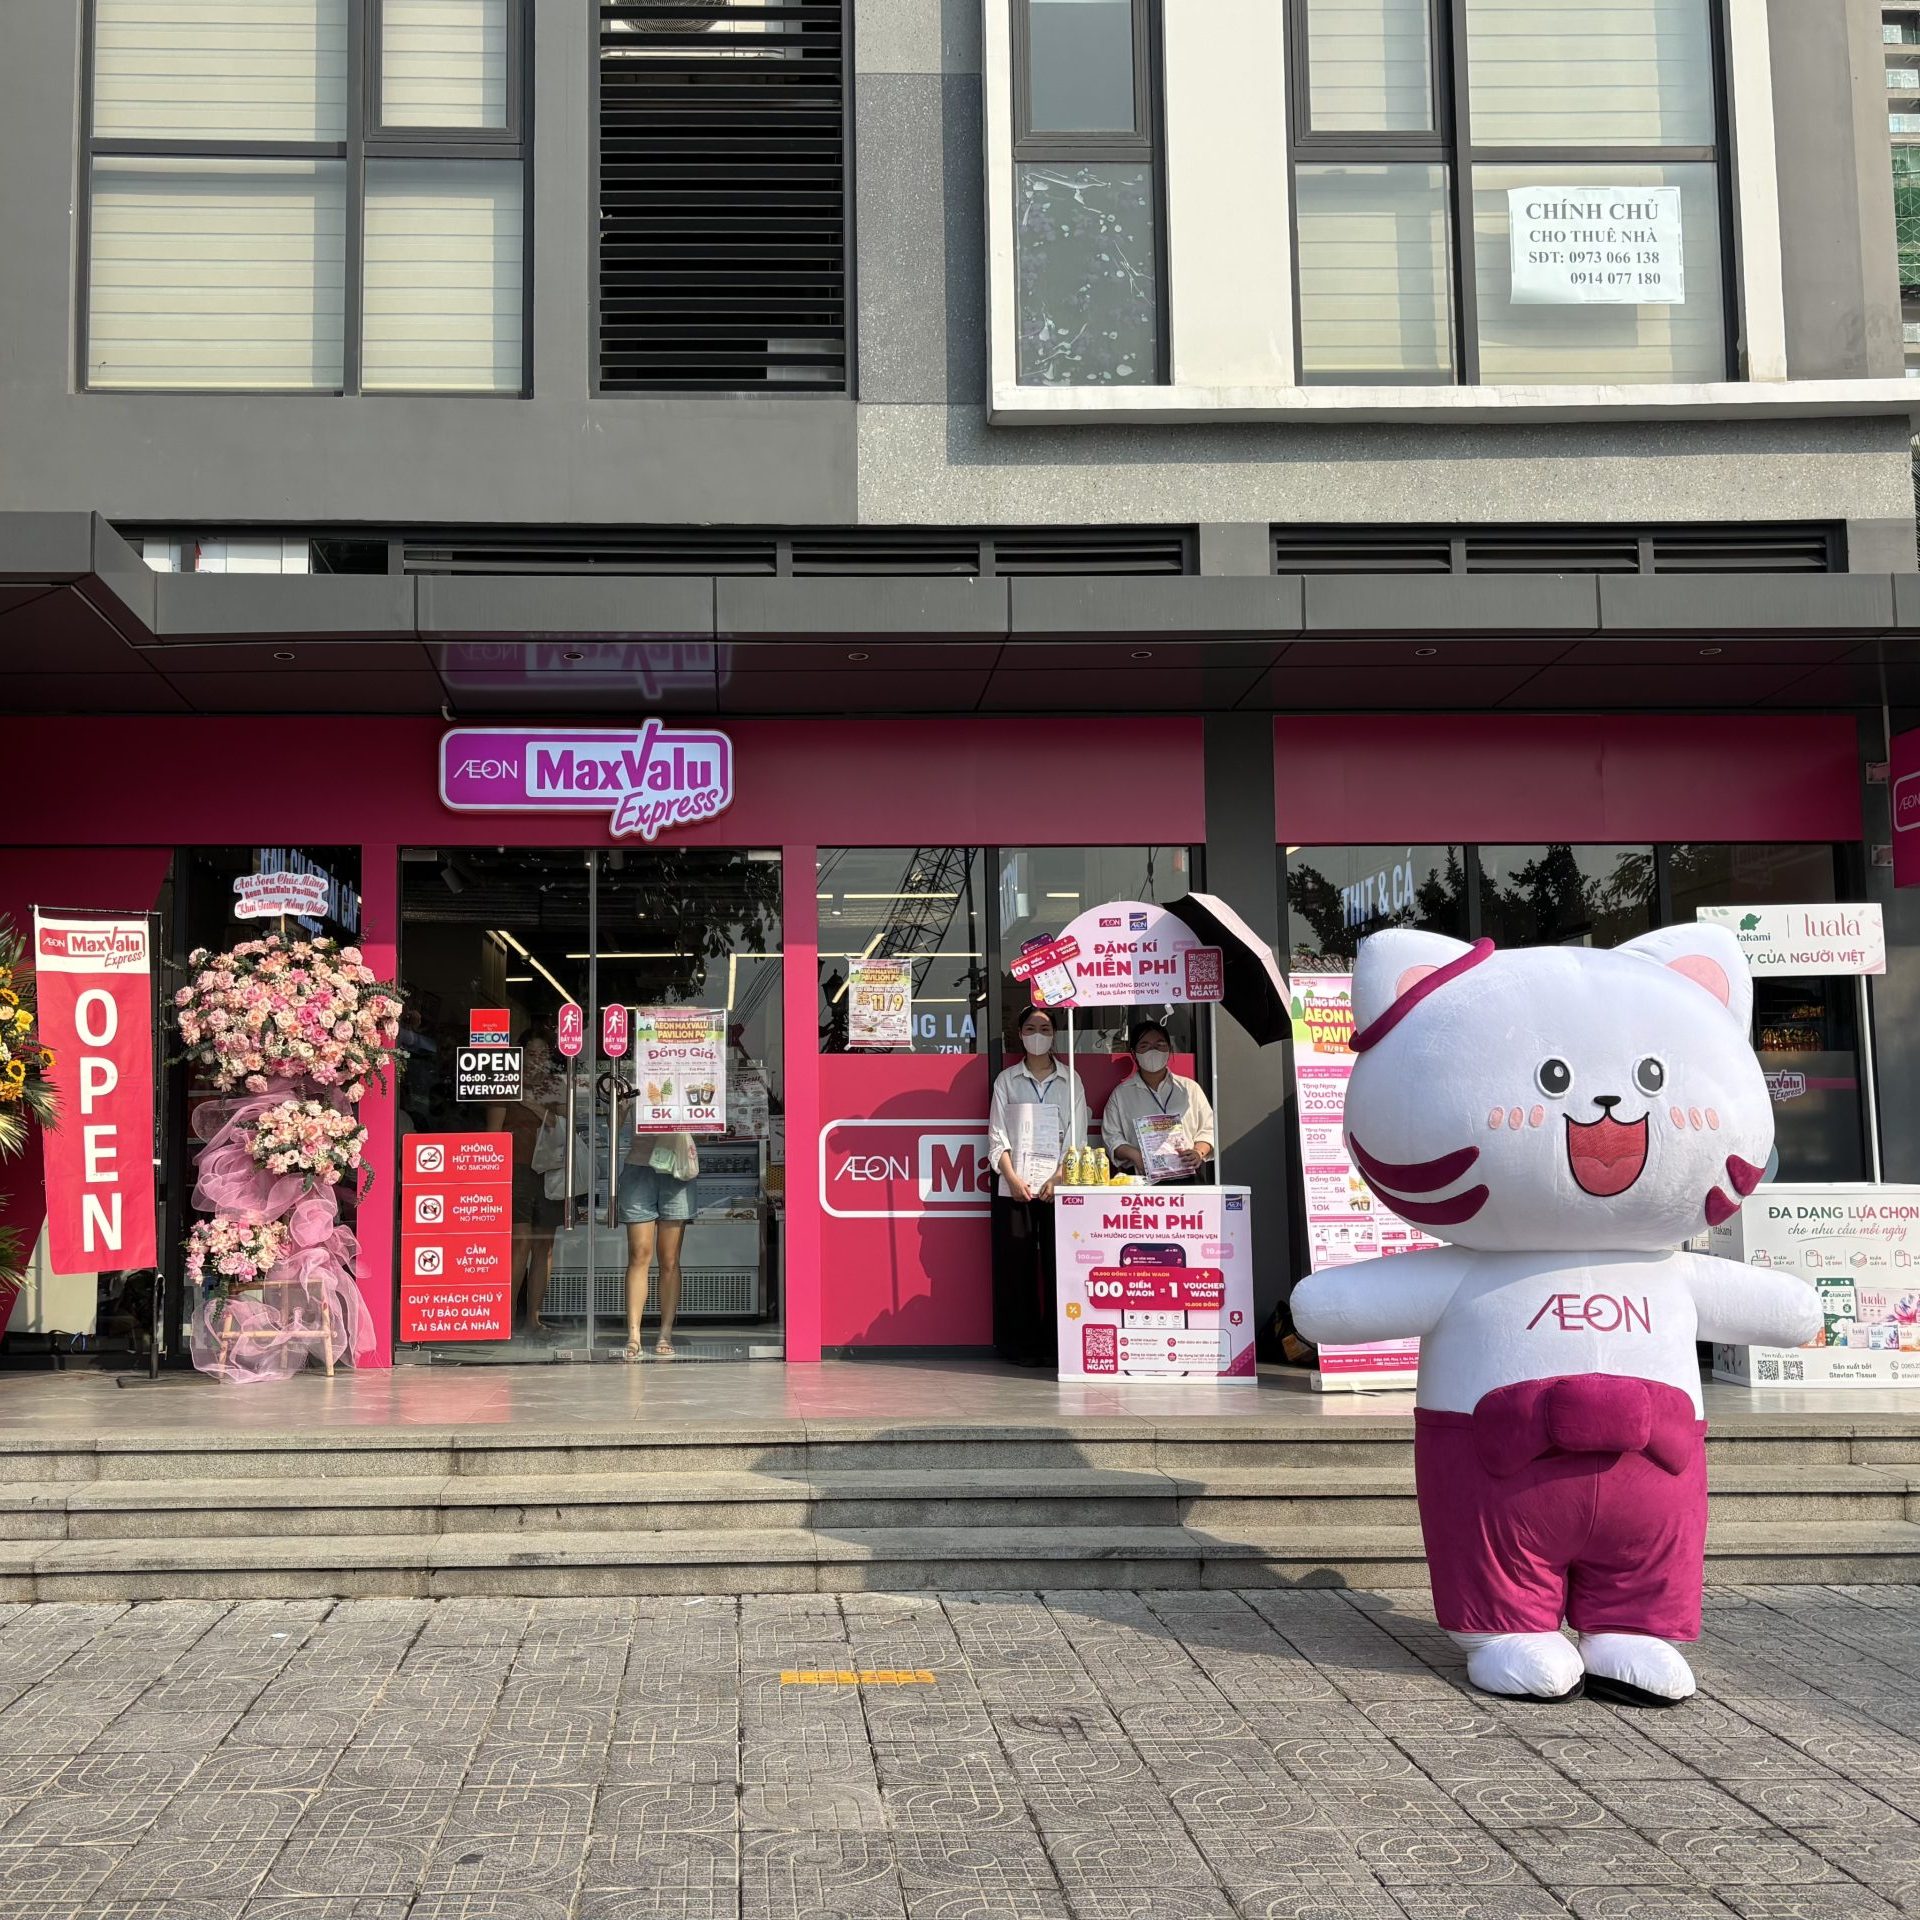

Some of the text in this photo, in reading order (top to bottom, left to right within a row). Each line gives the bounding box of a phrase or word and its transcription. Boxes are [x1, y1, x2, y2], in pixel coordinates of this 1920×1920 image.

[1526, 199, 1658, 220] CHÍNH CHỦ
[1530, 228, 1657, 242] CHO THUÊ NHÀ
[1529, 251, 1660, 264] SĐT: 0973 066 138
[1570, 272, 1660, 284] 0914 077 180
[453, 724, 712, 790] AEON MaxValu
[615, 788, 718, 835] Express
[1378, 872, 1390, 916] &
[1393, 848, 1414, 911] CÁ
[1804, 914, 1860, 937] luala
[72, 926, 140, 952] MaxValu
[1094, 939, 1158, 954] ĐĂNG KÍ
[104, 952, 142, 969] Express
[1758, 950, 1865, 964] CỦA NGƯỜI VIỆT
[1077, 954, 1132, 977] MIỄN
[1139, 954, 1177, 974] PHÍ
[871, 994, 904, 1011] 11/9
[1304, 1007, 1342, 1023] AEON
[655, 1021, 674, 1029] AEON
[472, 1033, 508, 1042] SECOM
[658, 1030, 694, 1039] PAVILION
[648, 1046, 714, 1060] Đồng Giá
[460, 1053, 520, 1072] OPEN
[460, 1074, 486, 1082] 06:00
[494, 1074, 519, 1082] 22:00
[460, 1085, 519, 1095] EVERYDAY
[652, 1108, 672, 1118] 5K
[687, 1108, 716, 1118] 10K
[75, 989, 122, 1252] OPEN
[461, 1143, 494, 1152] KHÔNG
[834, 1155, 910, 1182] AEON
[460, 1194, 493, 1204] KHÔNG
[1121, 1194, 1184, 1207] ĐĂNG KÍ
[1103, 1206, 1204, 1230] MIỄN PHÍ
[1768, 1204, 1920, 1222] ĐA DẠNG LỰA CHỌN
[1788, 1223, 1808, 1234] cho
[1812, 1223, 1834, 1234] nhu
[1882, 1224, 1908, 1241] ngày
[476, 1256, 498, 1265] NUÔI
[1085, 1281, 1124, 1298] 100
[1129, 1280, 1151, 1289] ĐIỂM
[1169, 1282, 1178, 1298] 1
[434, 1293, 468, 1304] KHÁCH
[1860, 1292, 1886, 1304] luala
[437, 1306, 458, 1318] BẢO
[462, 1306, 490, 1317] QUẢN
[1526, 1293, 1651, 1334] AEON
[411, 1320, 500, 1332] TÀI SẢN CÁ NHÂN
